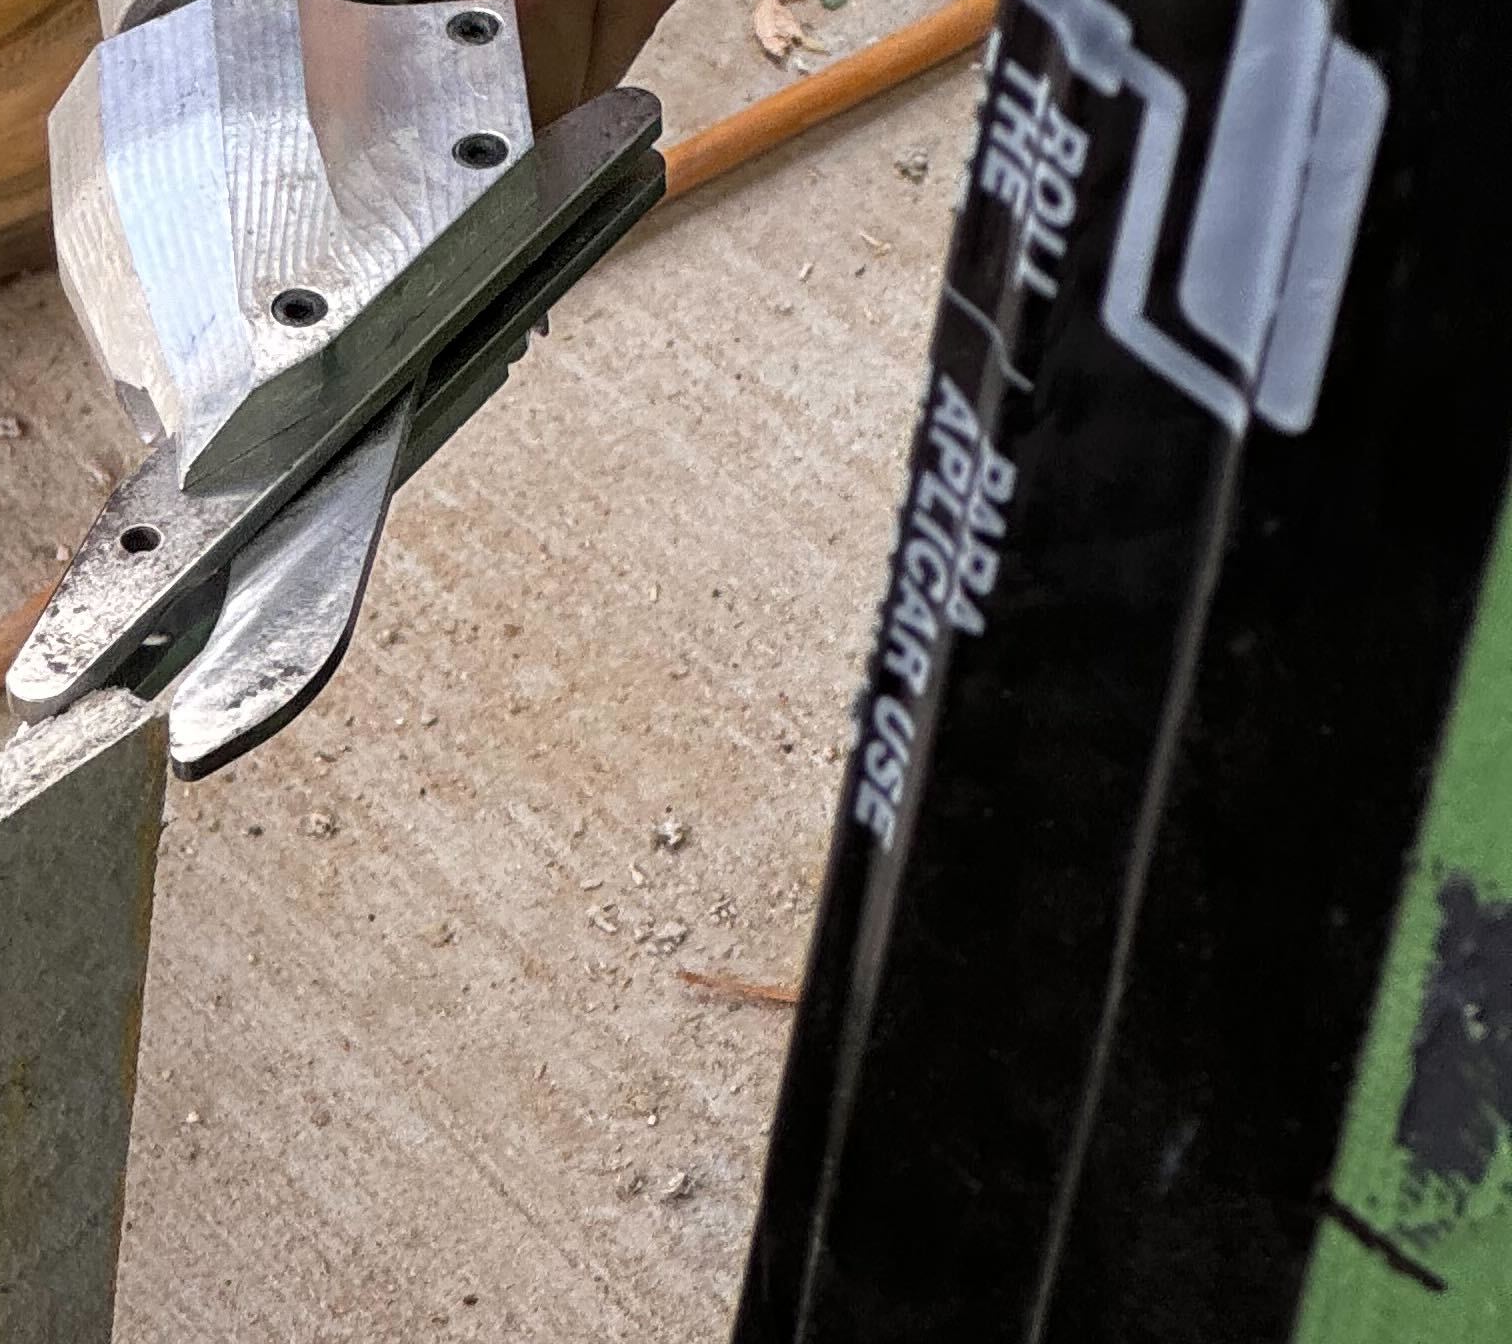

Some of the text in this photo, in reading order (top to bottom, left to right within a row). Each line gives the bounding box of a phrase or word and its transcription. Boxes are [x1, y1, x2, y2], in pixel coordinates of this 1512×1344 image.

[979, 57, 1053, 220] THE
[1014, 101, 1090, 300] ROLL
[854, 372, 980, 852] APLICAR USE
[944, 432, 1018, 637] PARA
